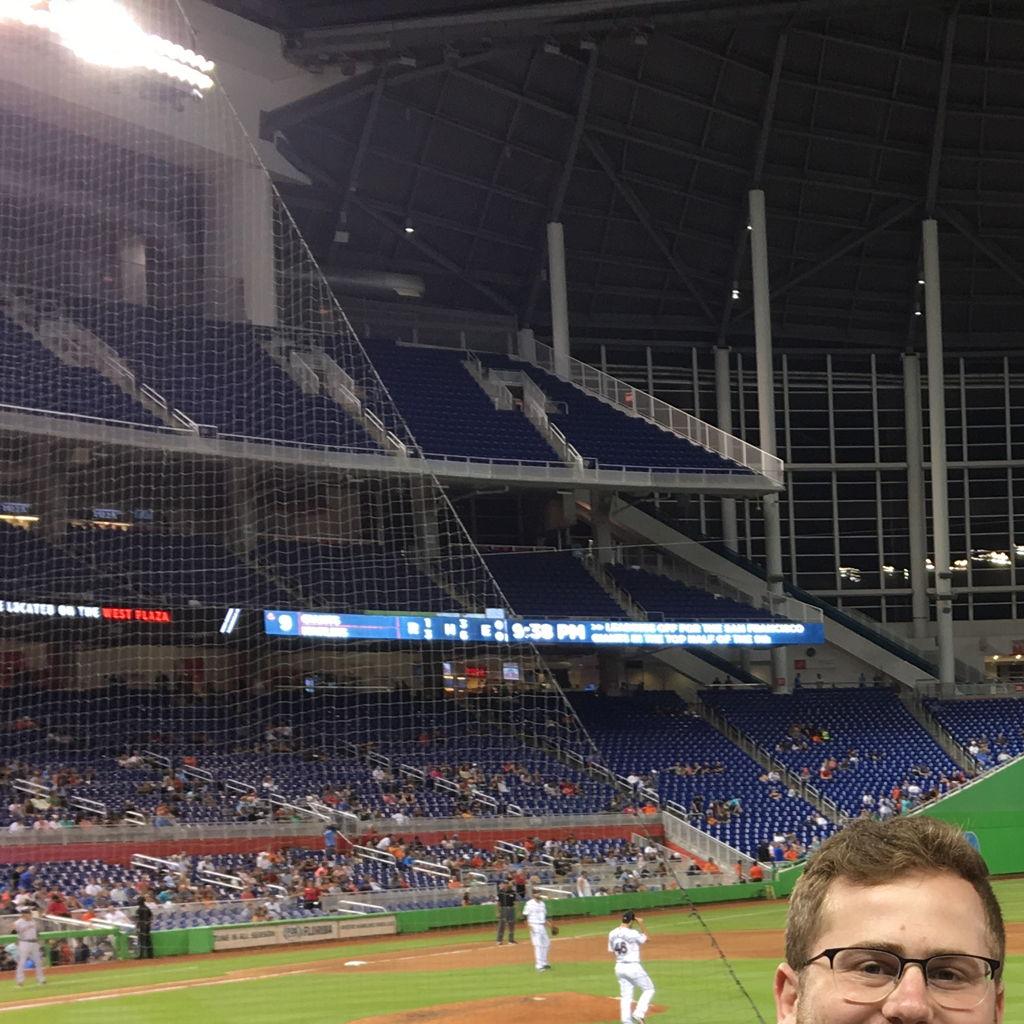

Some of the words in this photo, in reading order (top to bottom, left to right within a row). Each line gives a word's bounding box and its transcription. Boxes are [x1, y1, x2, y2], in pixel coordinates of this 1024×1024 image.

[102, 608, 132, 620] WEST
[135, 609, 170, 622] PLAZA
[557, 624, 586, 640] PM
[614, 941, 628, 954] 46
